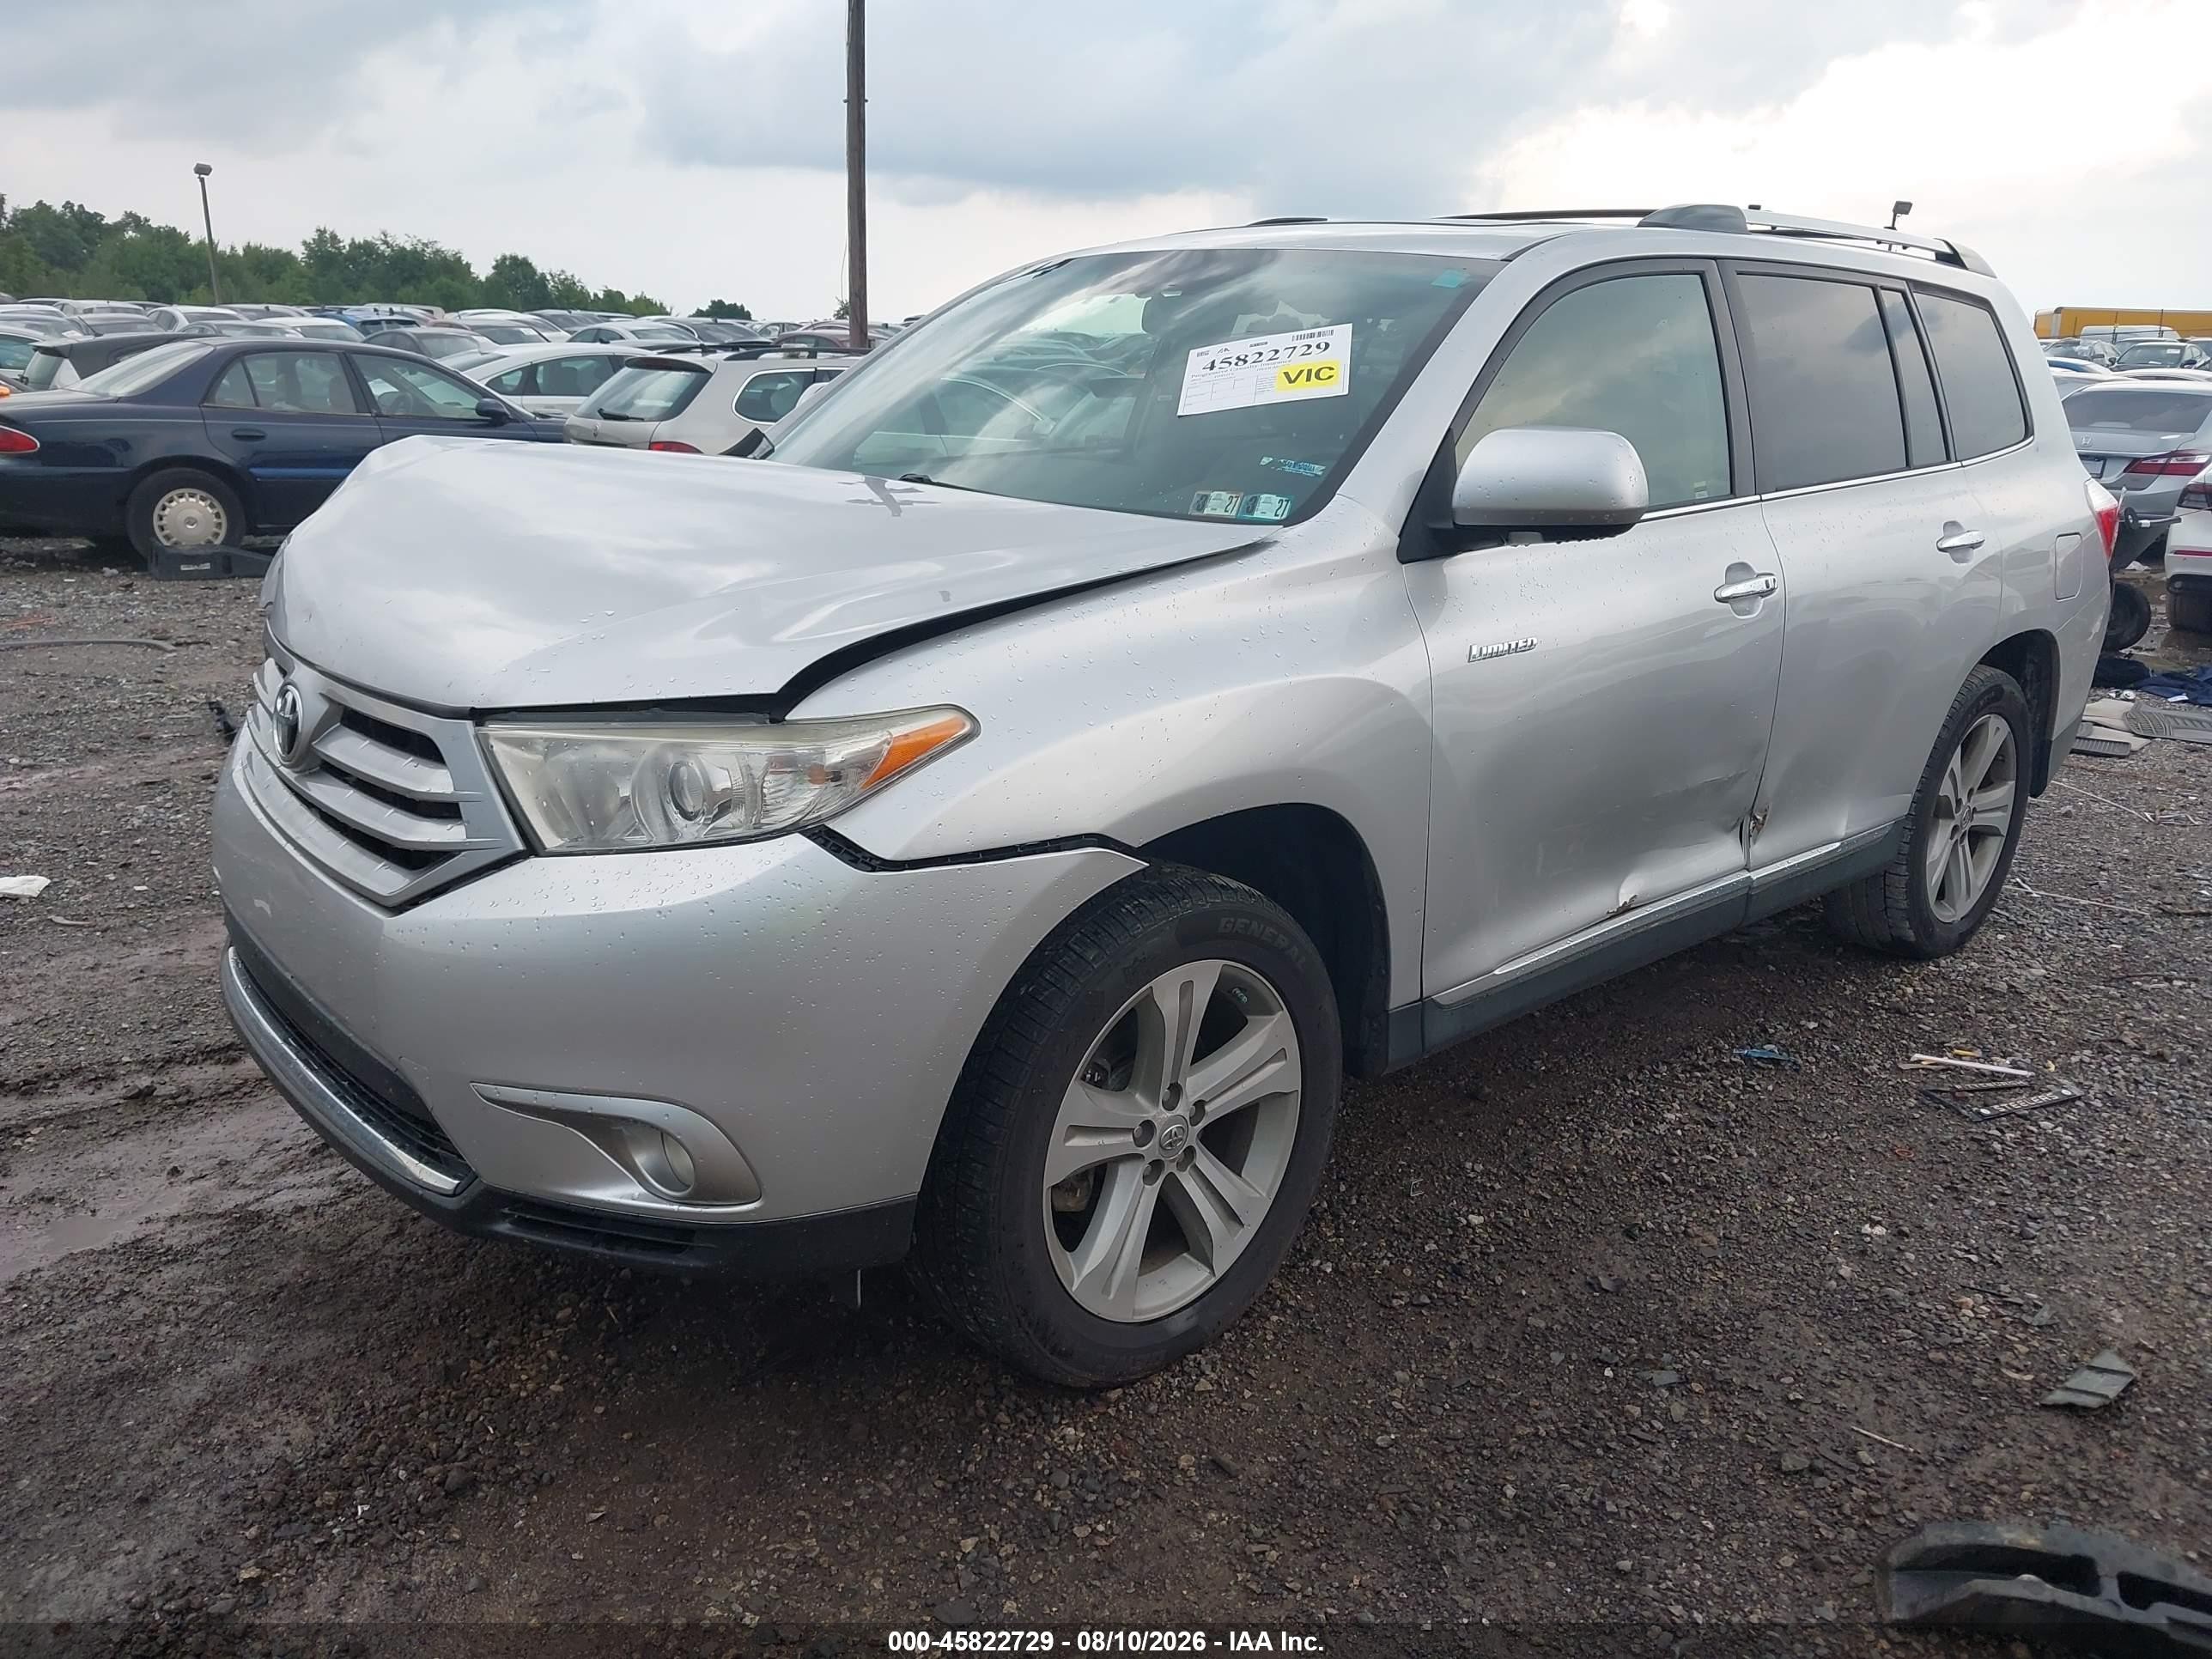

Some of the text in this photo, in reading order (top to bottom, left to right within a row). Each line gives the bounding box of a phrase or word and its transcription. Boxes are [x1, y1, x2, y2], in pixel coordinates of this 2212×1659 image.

[1202, 341, 1331, 372] 45822729
[1282, 366, 1335, 385] VIC
[1224, 495, 1240, 514] 27
[1274, 499, 1290, 517] 27
[1468, 637, 1538, 663] LIMITED
[1218, 916, 1306, 969] GENERAL
[1992, 1092, 2059, 1112] STEELERS
